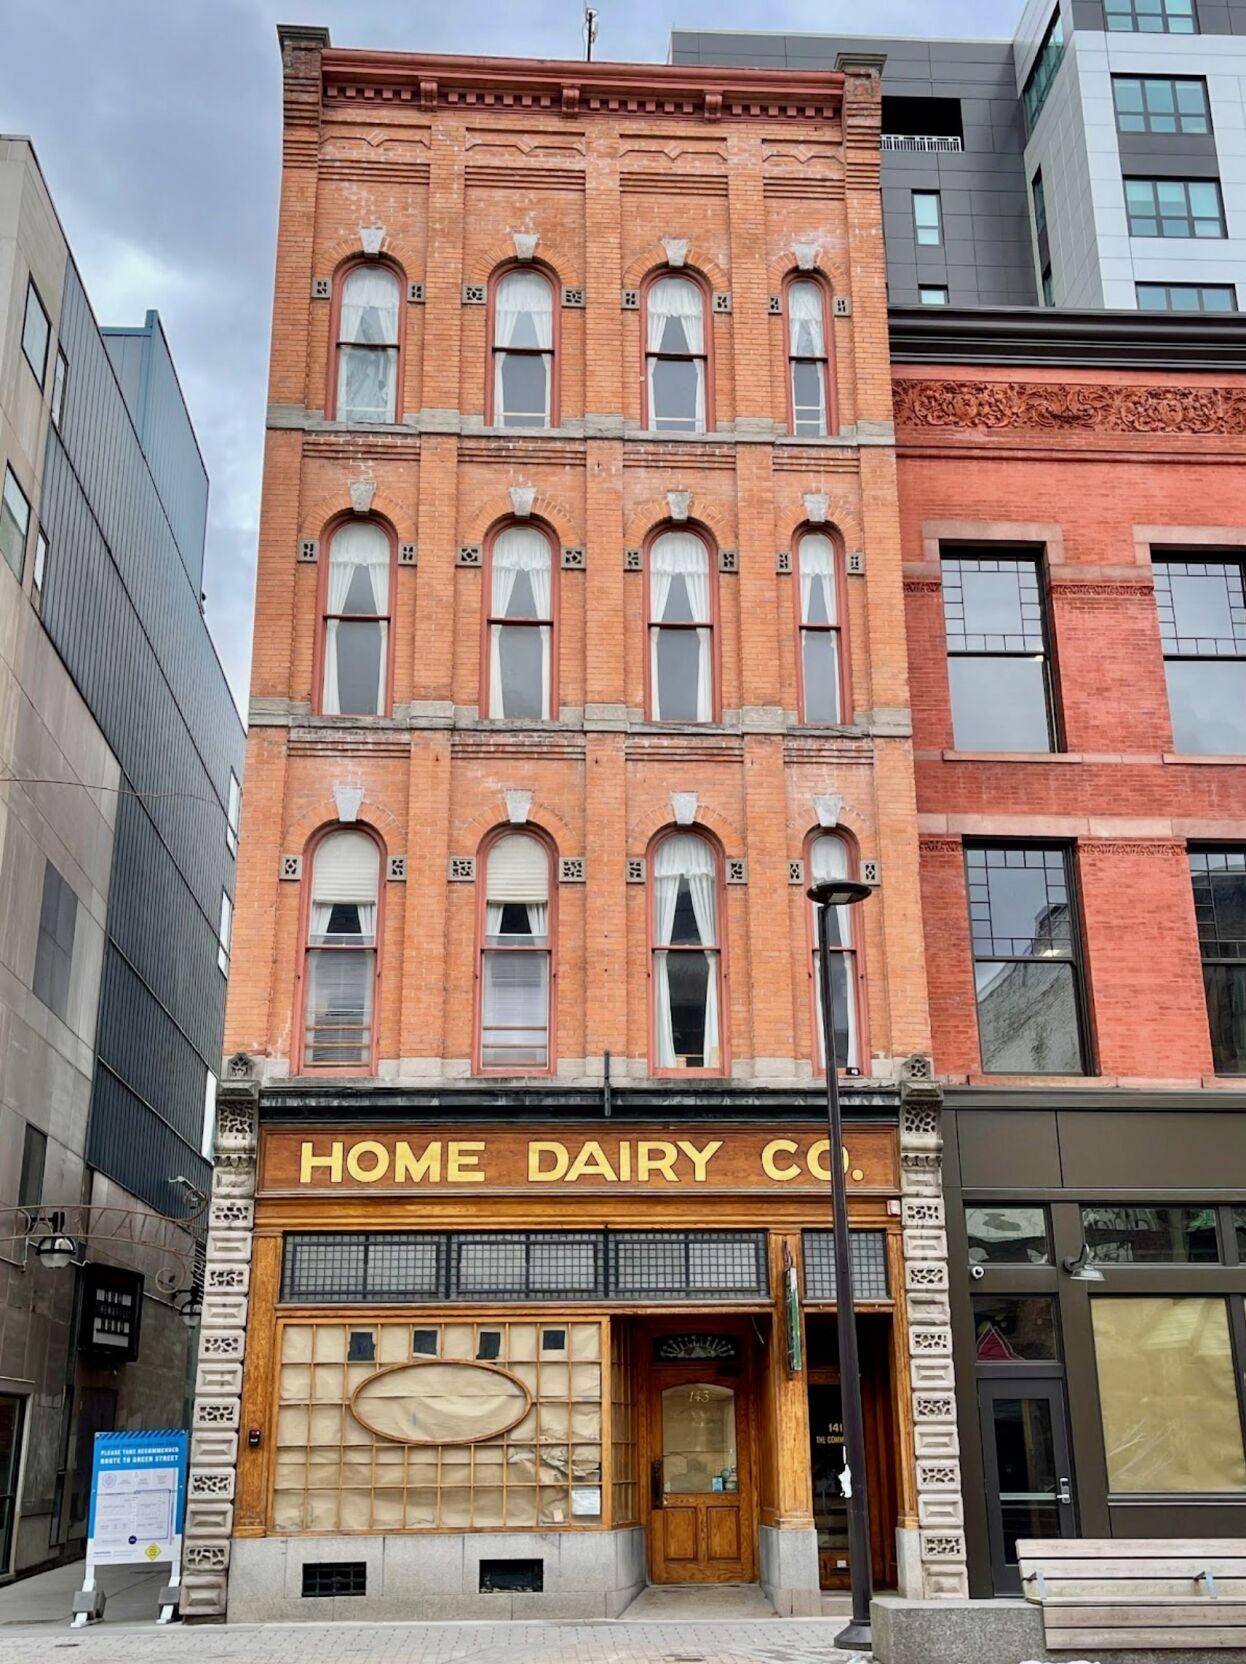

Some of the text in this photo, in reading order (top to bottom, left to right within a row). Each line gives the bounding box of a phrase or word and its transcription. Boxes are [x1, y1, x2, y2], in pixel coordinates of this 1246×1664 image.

[300, 1138, 865, 1184] HOME DAIRY CO.
